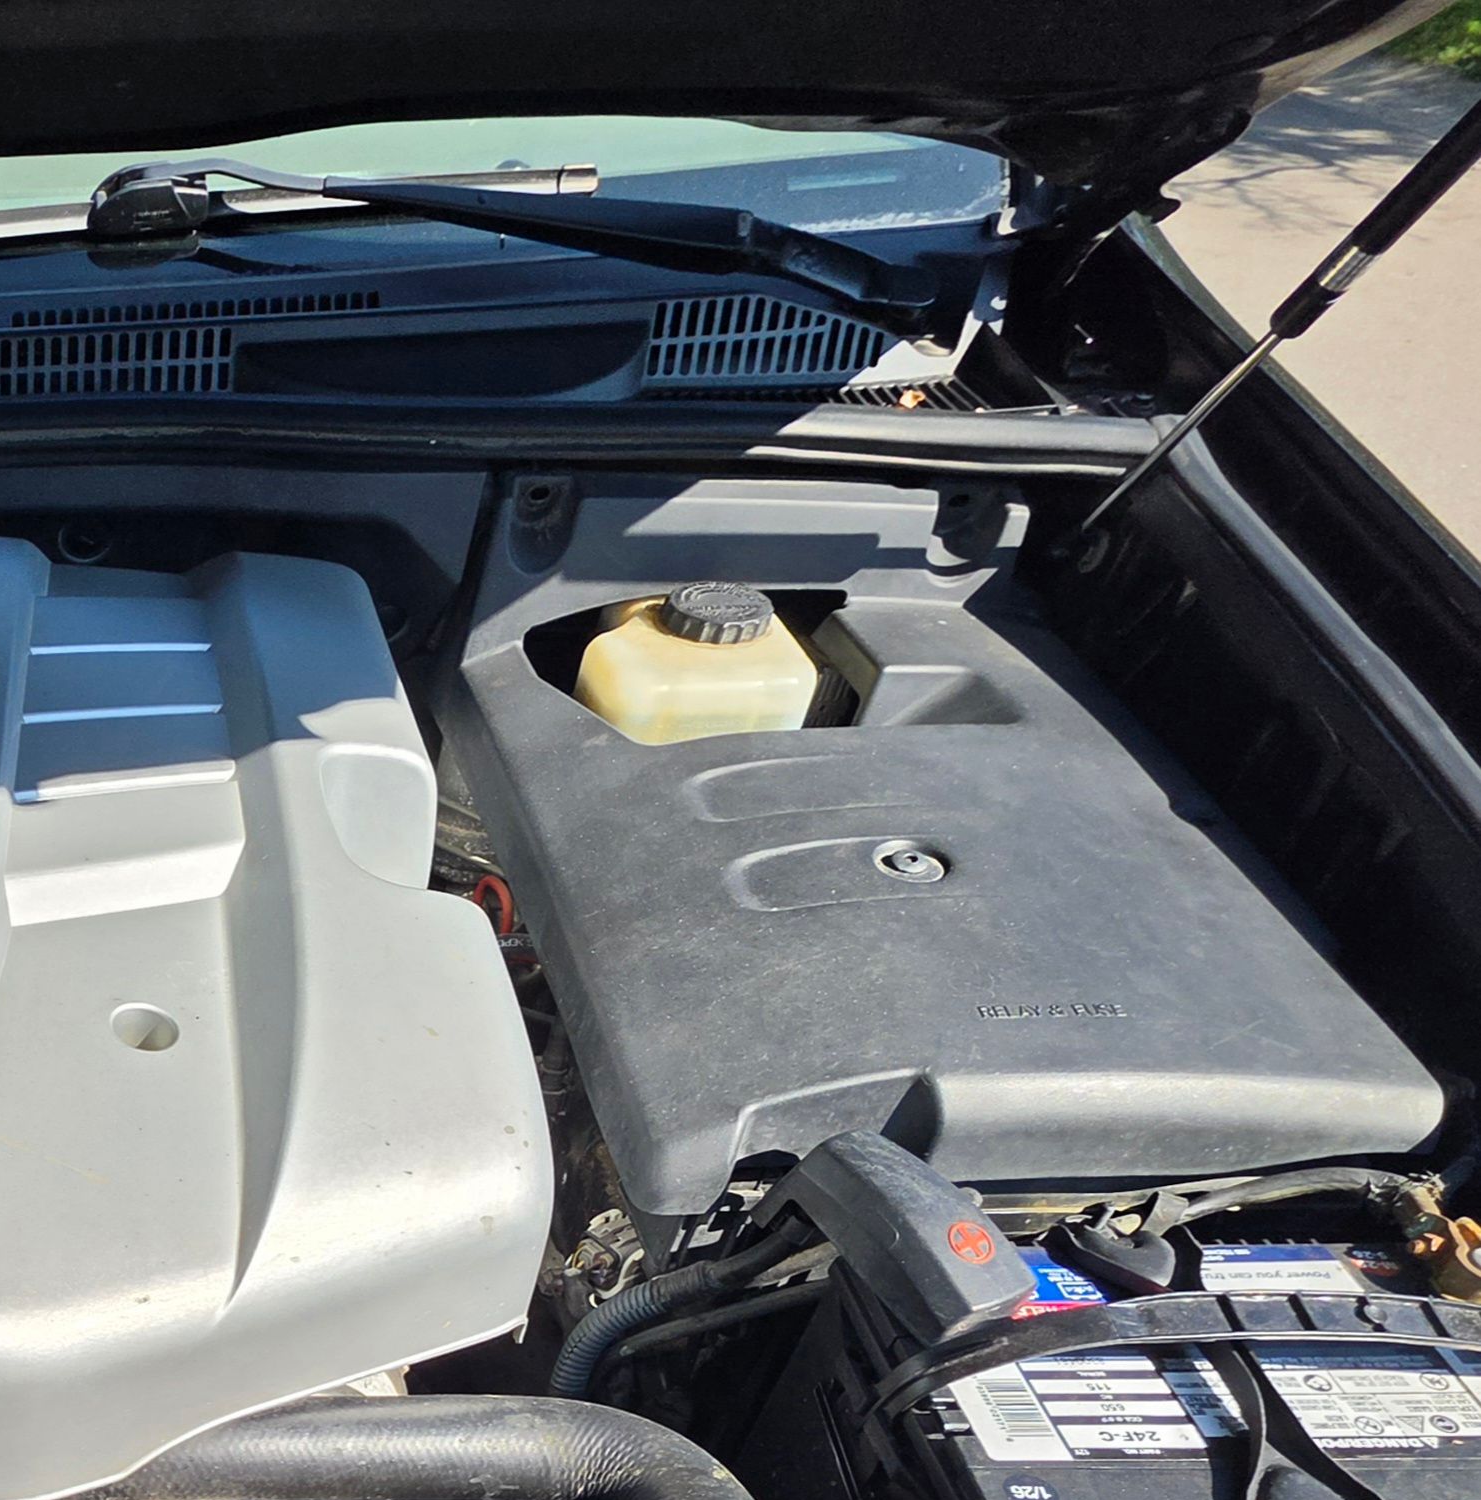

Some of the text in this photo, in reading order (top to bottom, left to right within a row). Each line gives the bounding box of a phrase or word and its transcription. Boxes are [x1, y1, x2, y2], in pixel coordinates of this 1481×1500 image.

[976, 1003, 1128, 1018] RELAY & FUSE
[1202, 1270, 1332, 1280] Power you can tru
[1086, 1383, 1112, 1392] 115
[1100, 1403, 1126, 1412] 650
[1098, 1431, 1161, 1442] 24F-C
[1009, 1485, 1052, 1500] 1/26
